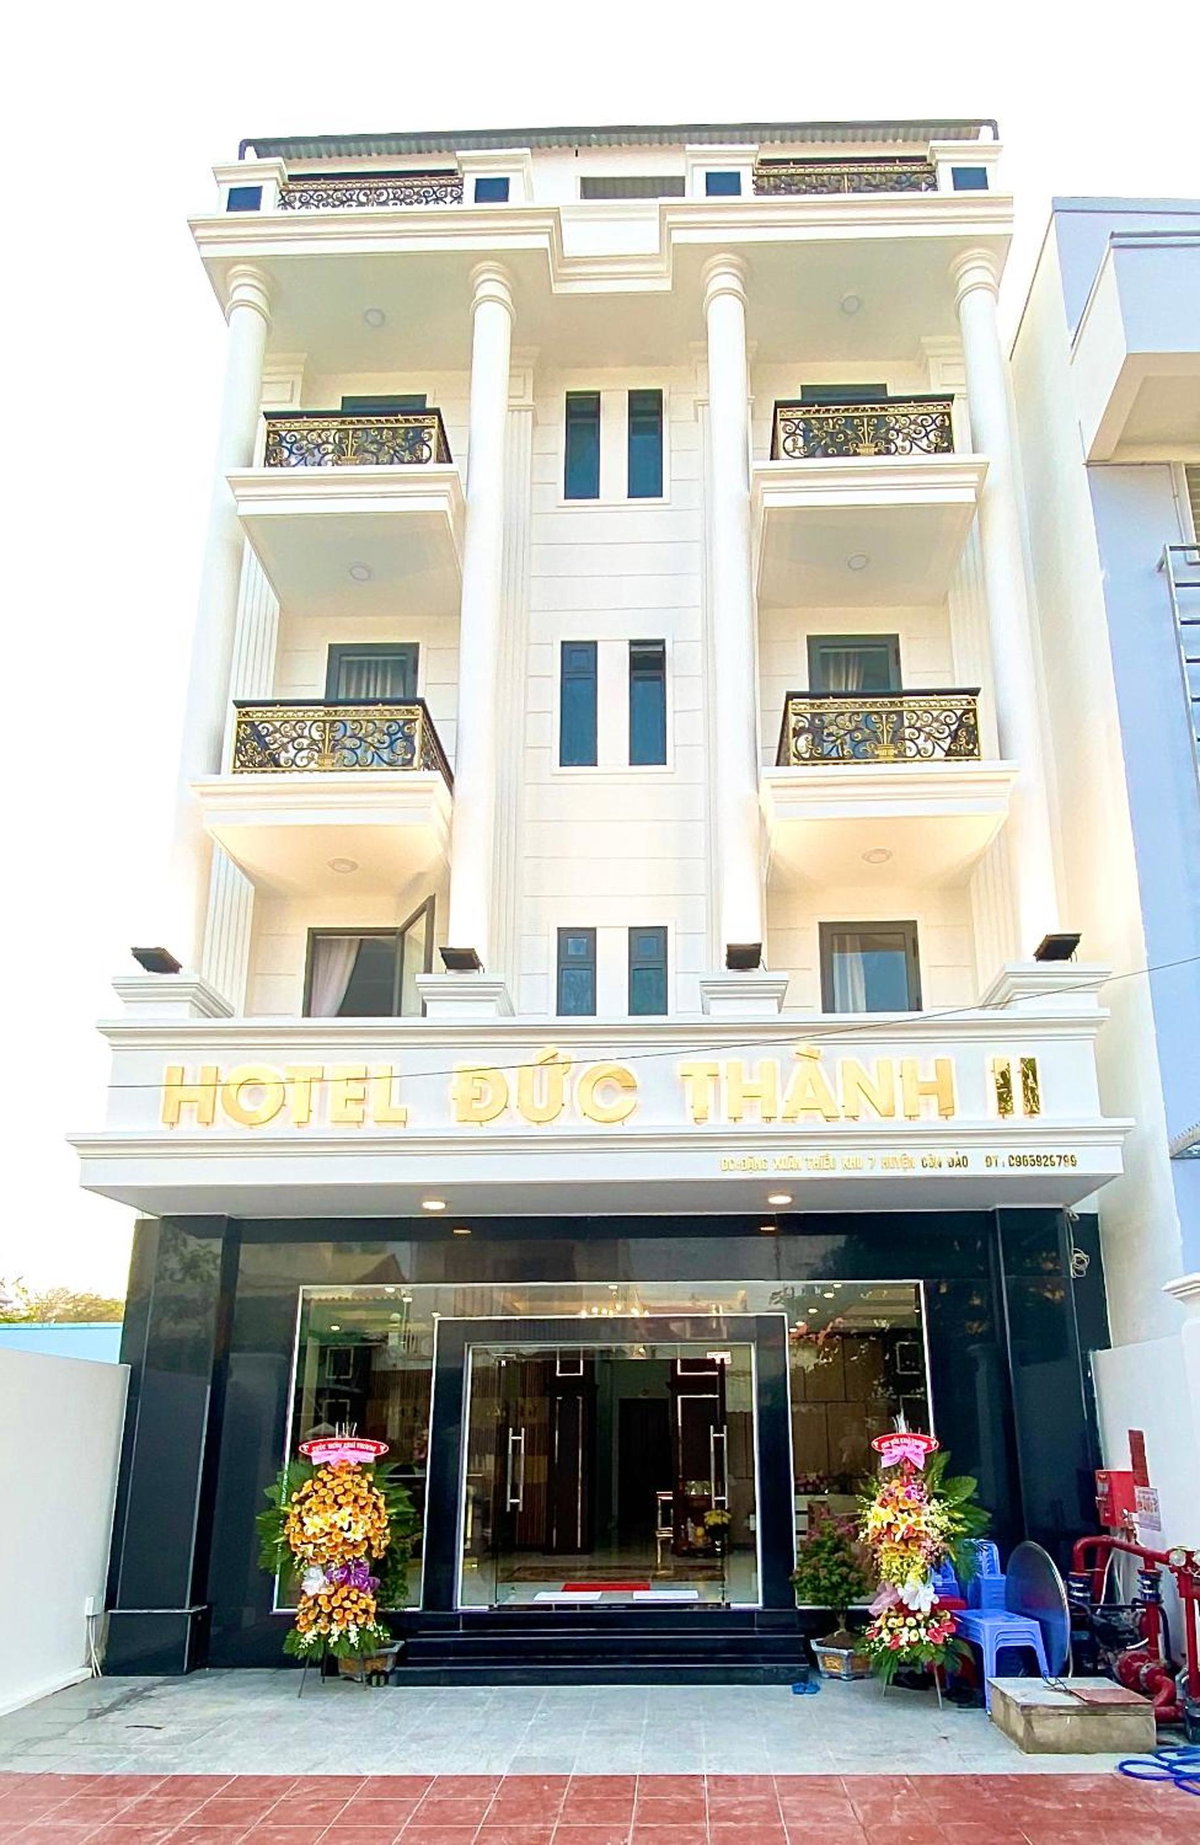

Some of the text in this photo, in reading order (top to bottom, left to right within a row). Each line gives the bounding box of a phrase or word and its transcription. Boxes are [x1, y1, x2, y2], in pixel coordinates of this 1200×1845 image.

[161, 1045, 1041, 1126] HOTEL ĐỨC THÀNH II
